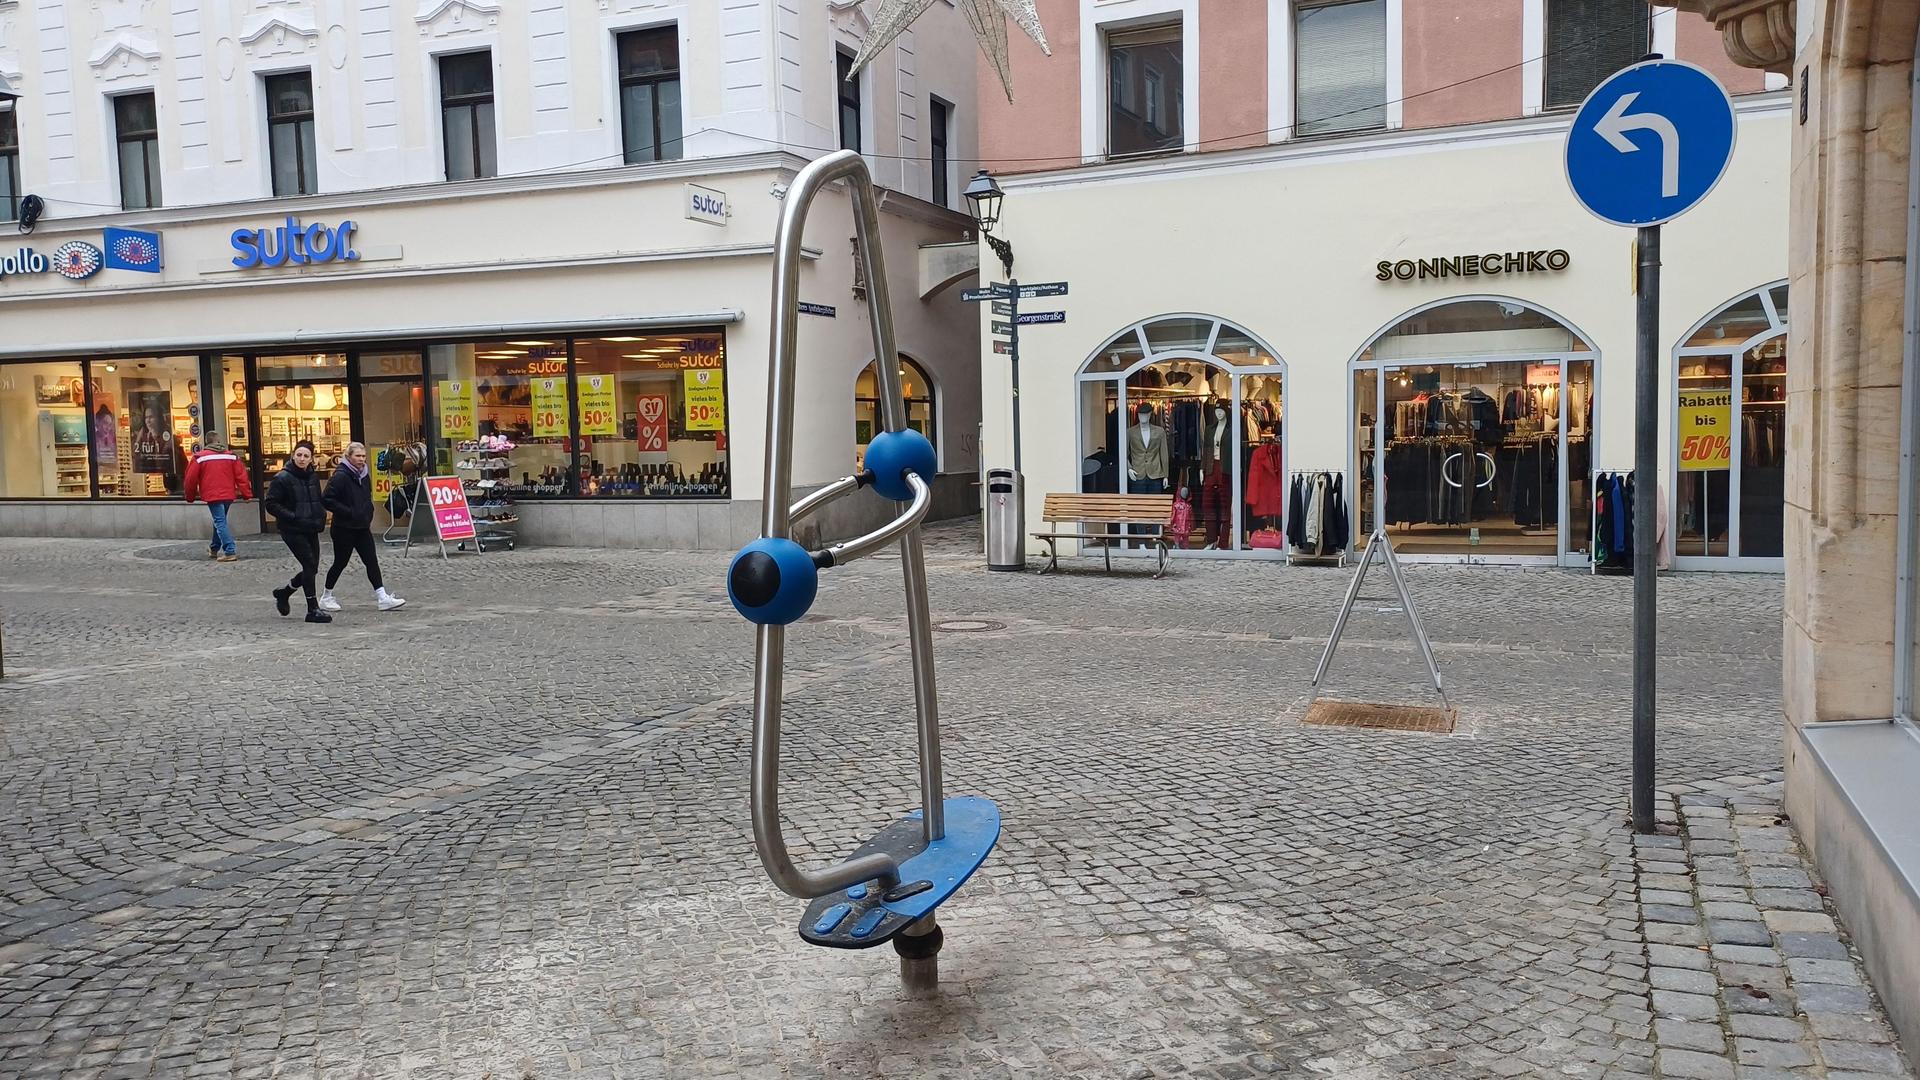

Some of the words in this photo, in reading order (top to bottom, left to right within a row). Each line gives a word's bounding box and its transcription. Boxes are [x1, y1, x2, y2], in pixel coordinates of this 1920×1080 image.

[693, 194, 725, 217] sutor.
[230, 215, 358, 268] sutor.
[1376, 249, 1571, 282] SONNECHKO
[1017, 311, 1063, 323] Georgenstraße
[528, 360, 566, 374] sutor.
[679, 353, 721, 368] sutor.
[644, 401, 659, 414] SV
[1679, 395, 1731, 408] Rabatt!
[536, 412, 564, 428] 50%
[584, 410, 612, 425] 50%
[690, 405, 720, 421] 50%
[1695, 415, 1717, 426] bis
[444, 413, 472, 429] 50%
[134, 442, 140, 453] 2
[1681, 434, 1731, 461] 50%
[431, 486, 463, 505] 20%
